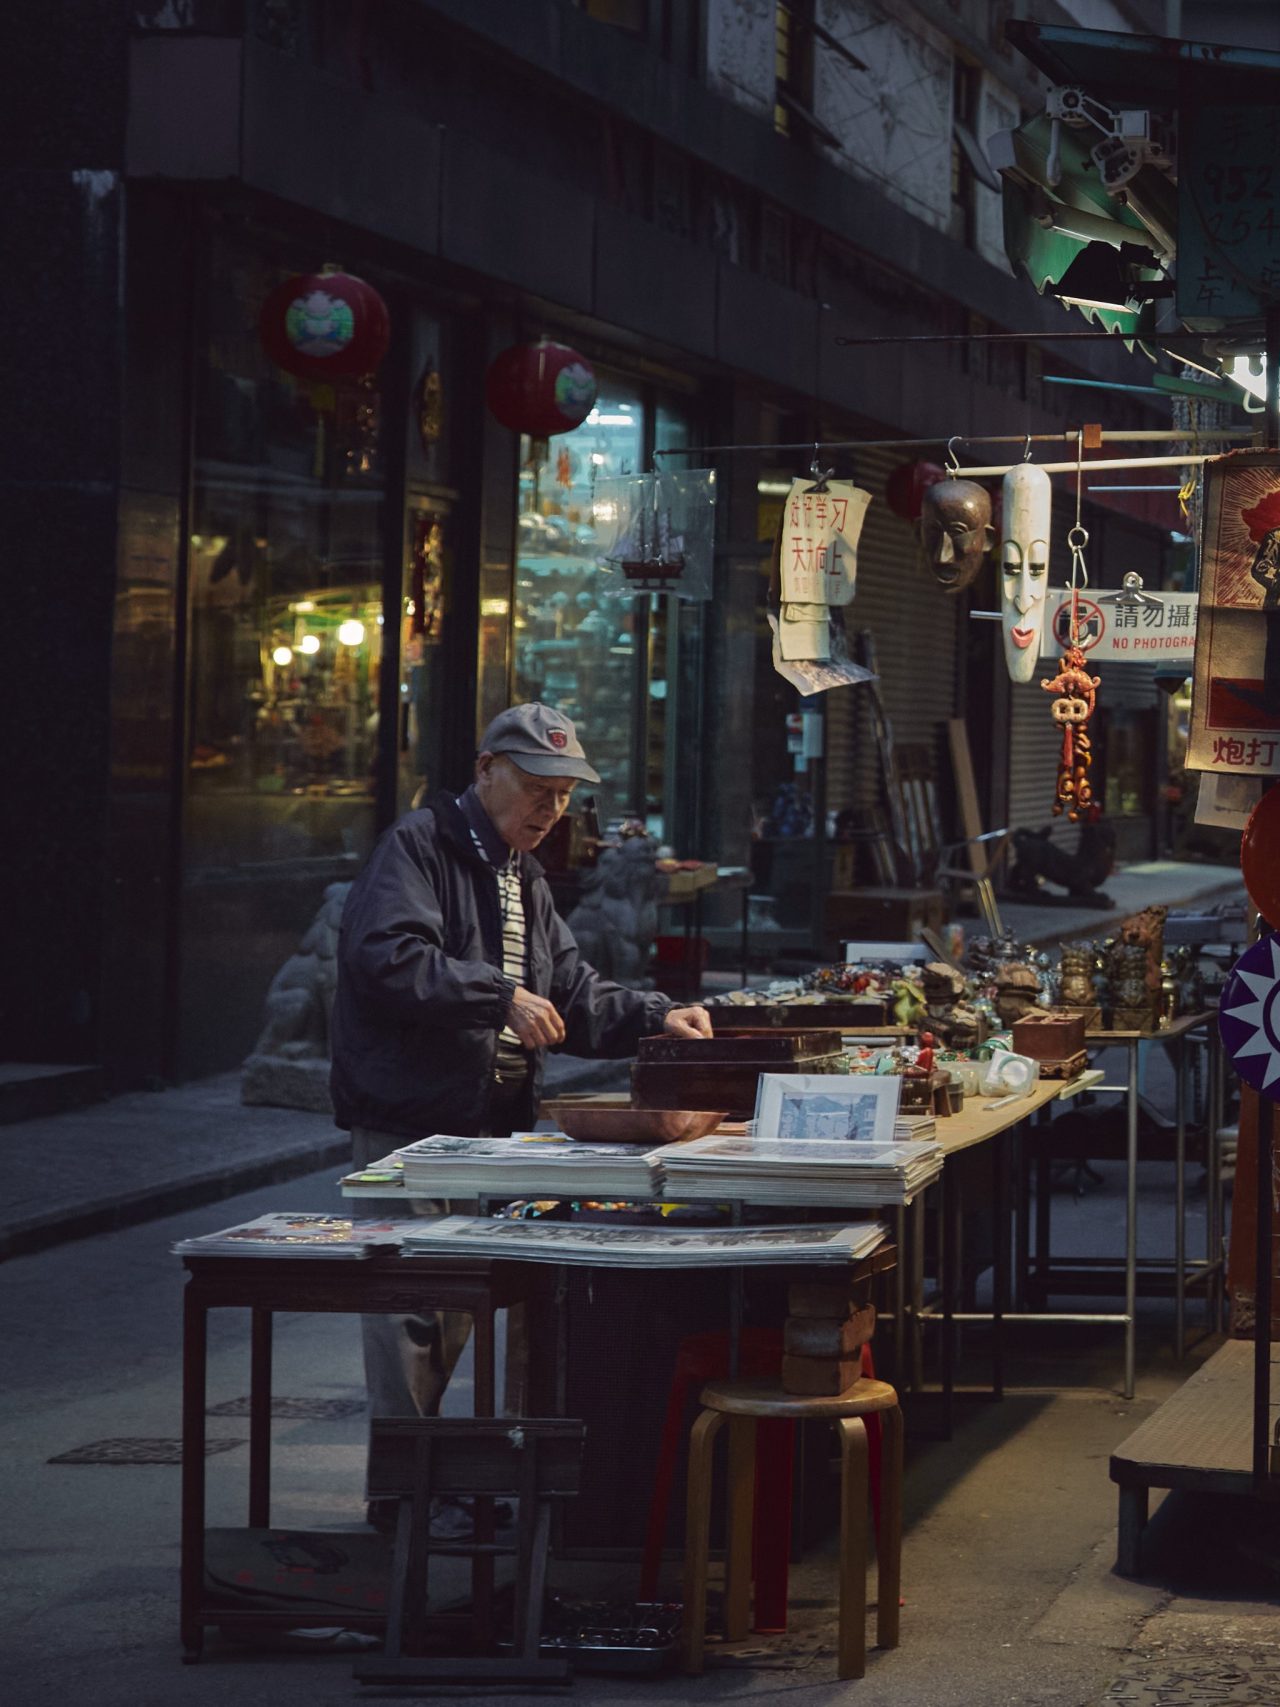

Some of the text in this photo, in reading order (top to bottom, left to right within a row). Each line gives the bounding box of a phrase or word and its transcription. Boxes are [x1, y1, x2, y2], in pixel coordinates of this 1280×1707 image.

[790, 495, 848, 532] 好好学习
[791, 539, 842, 575] 天天向上
[1114, 603, 1198, 628] 請勿攝
[1112, 638, 1128, 649] NO
